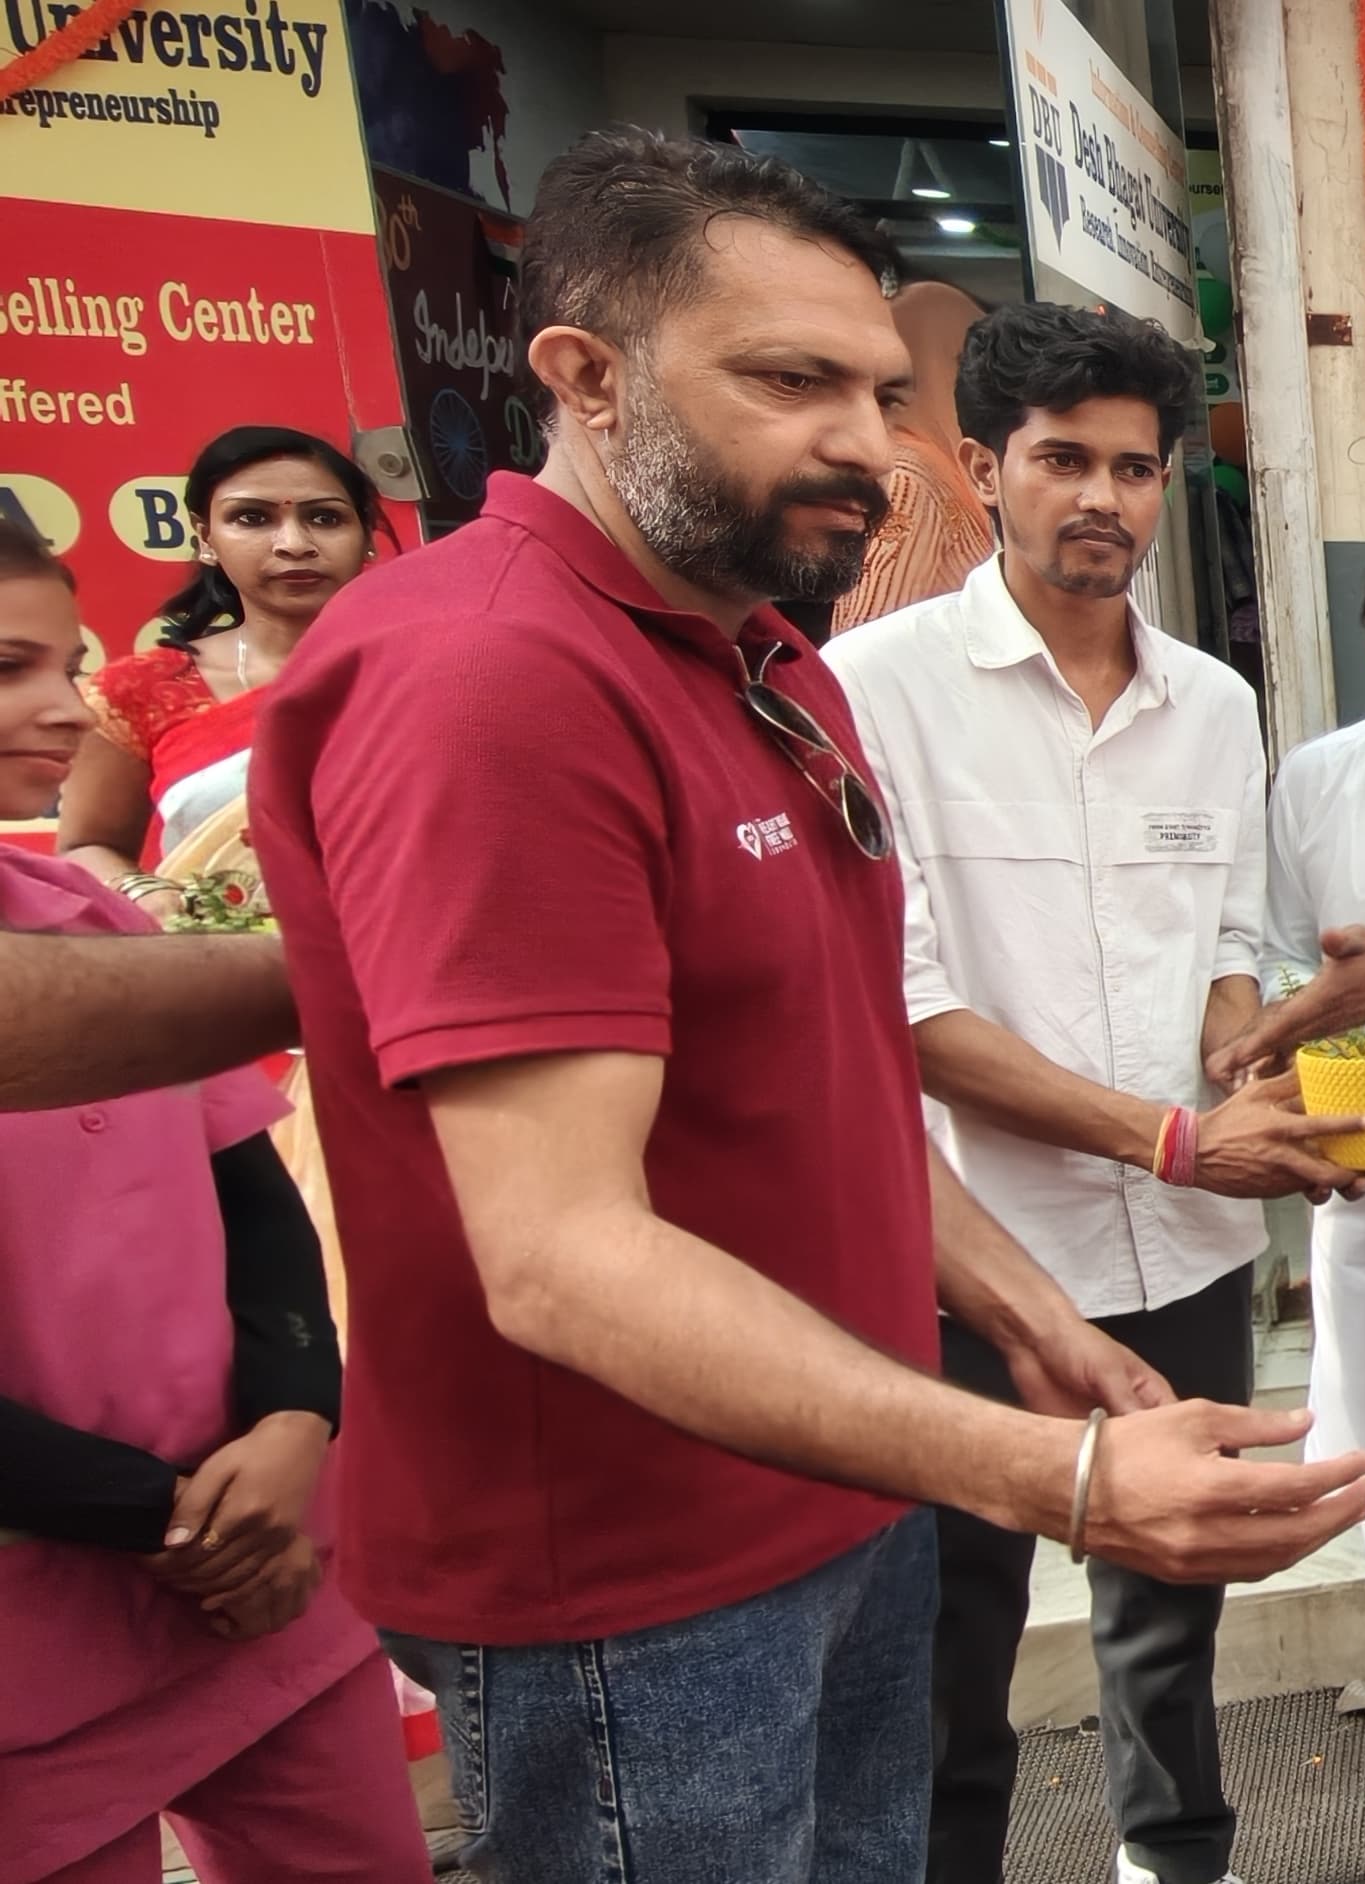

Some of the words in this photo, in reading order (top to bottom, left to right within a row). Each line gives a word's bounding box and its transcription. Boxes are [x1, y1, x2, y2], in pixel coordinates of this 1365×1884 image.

[1028, 83, 1063, 158] DBU
[1069, 100, 1105, 190] Desh
[1103, 133, 1146, 232] Bhagat
[158, 280, 316, 345] Center
